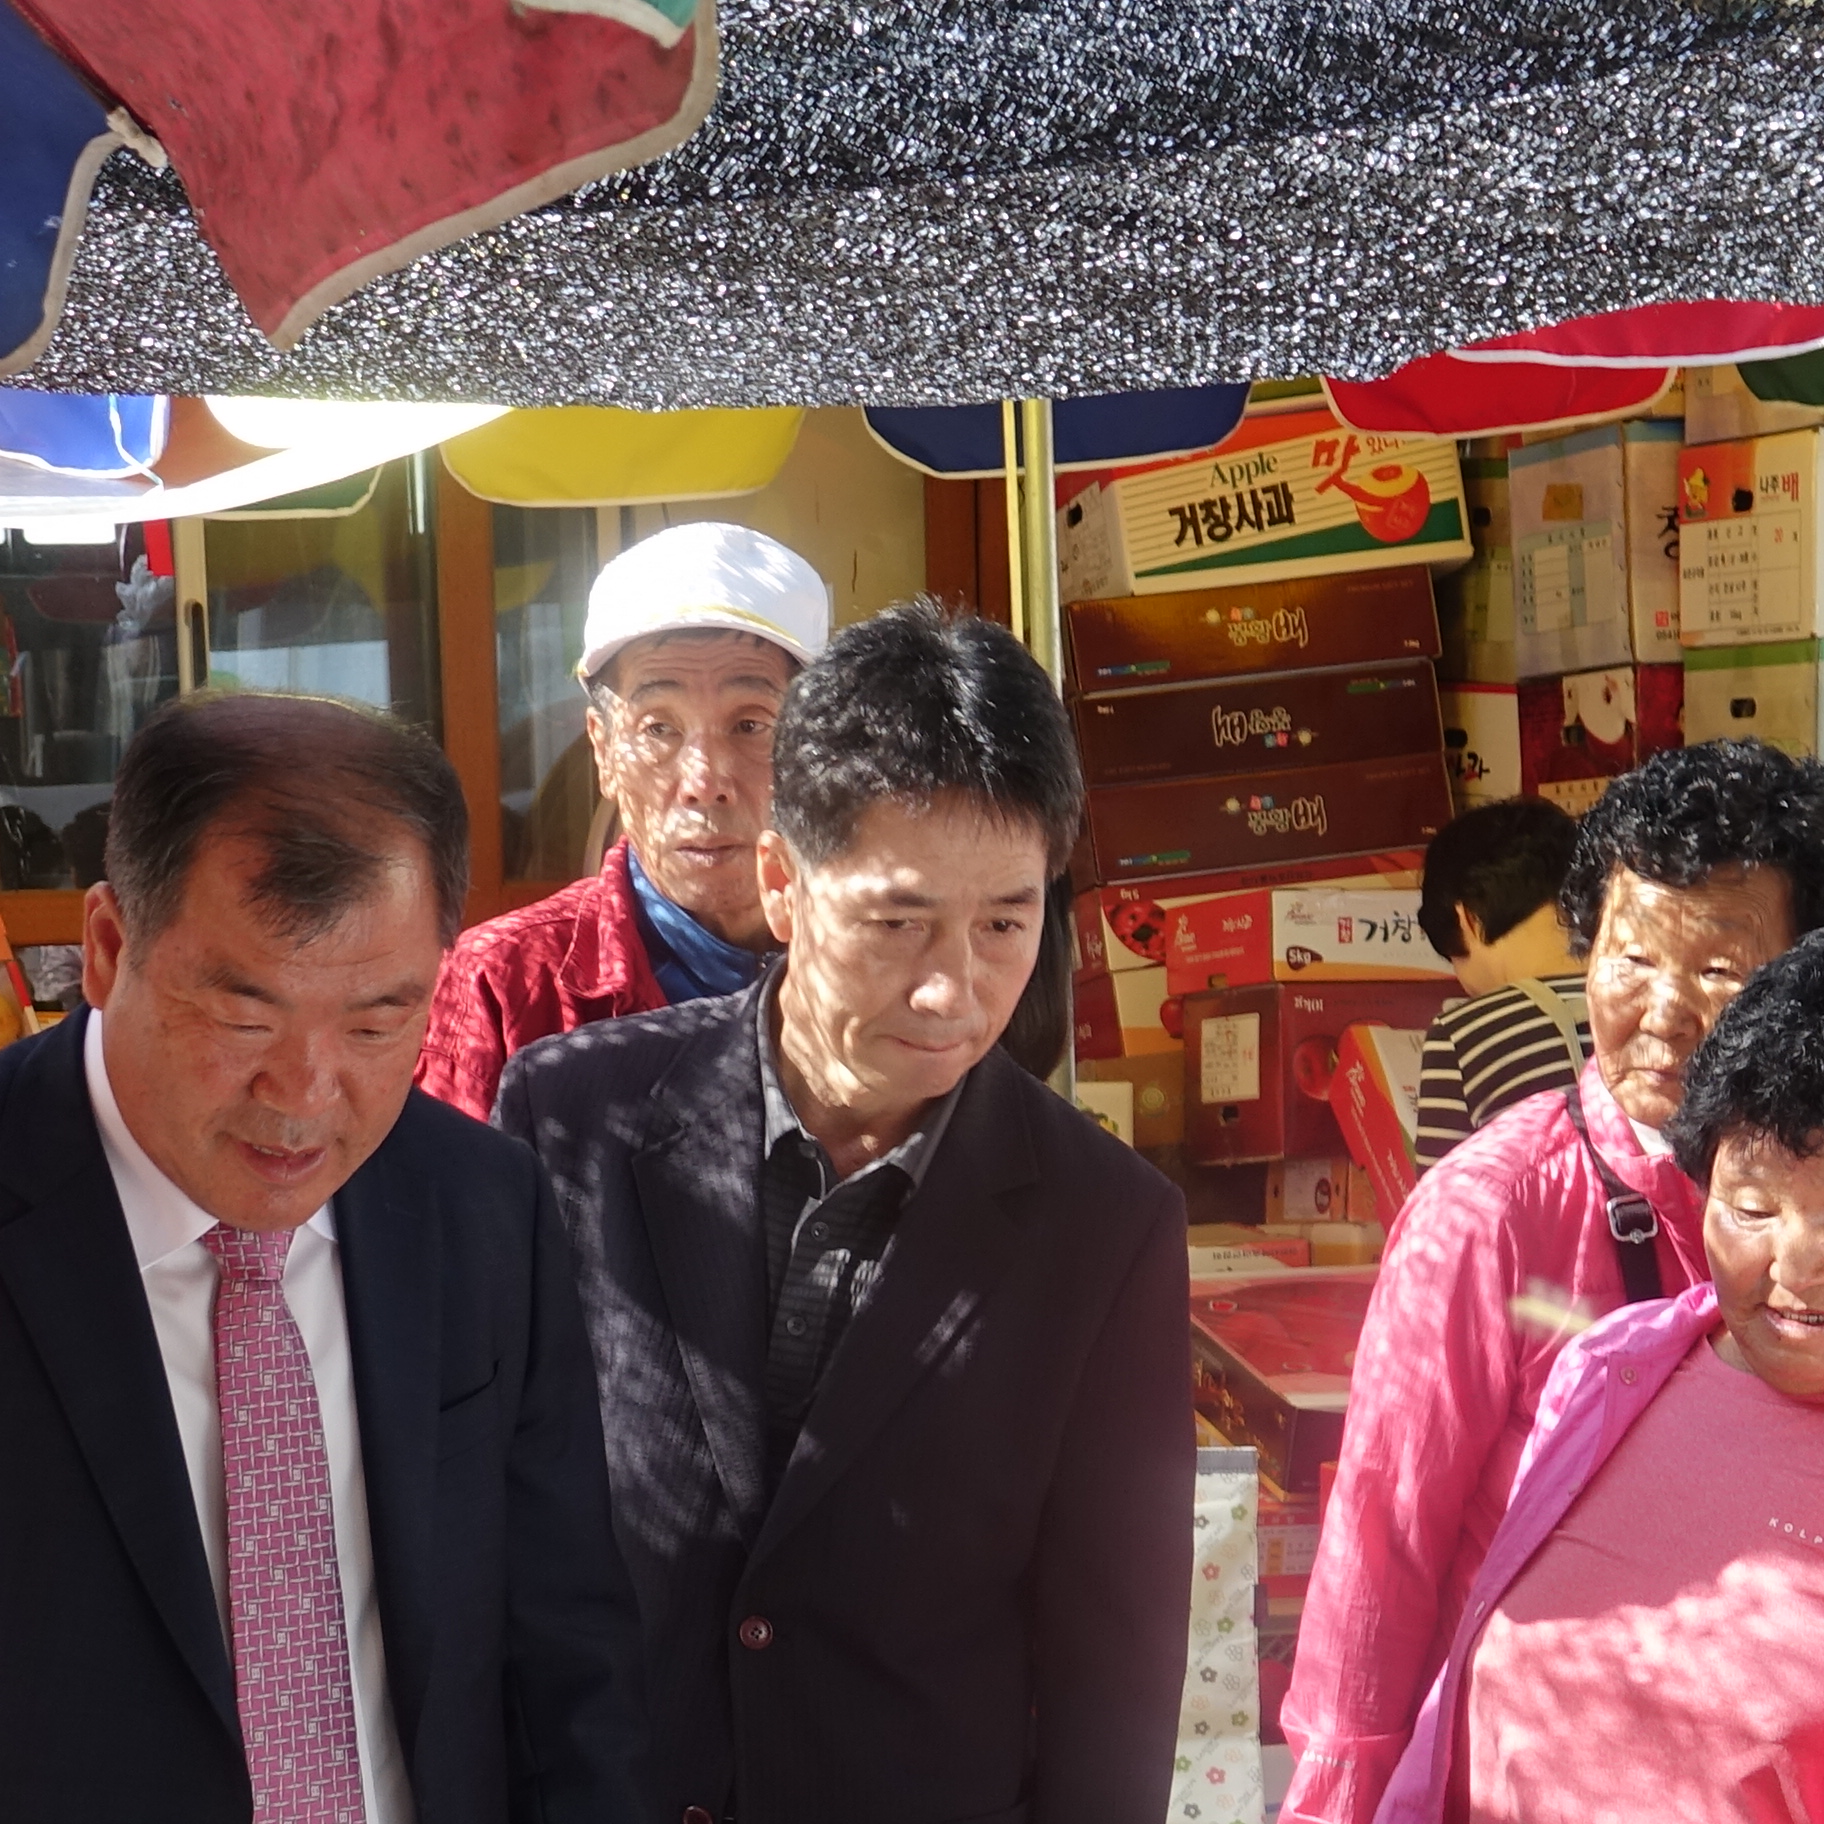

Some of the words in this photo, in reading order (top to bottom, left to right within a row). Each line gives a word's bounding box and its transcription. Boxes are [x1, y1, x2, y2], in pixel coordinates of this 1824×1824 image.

[1209, 452, 1278, 489] Apple
[1168, 481, 1296, 547] 거창사과
[1289, 949, 1312, 964] 5kg
